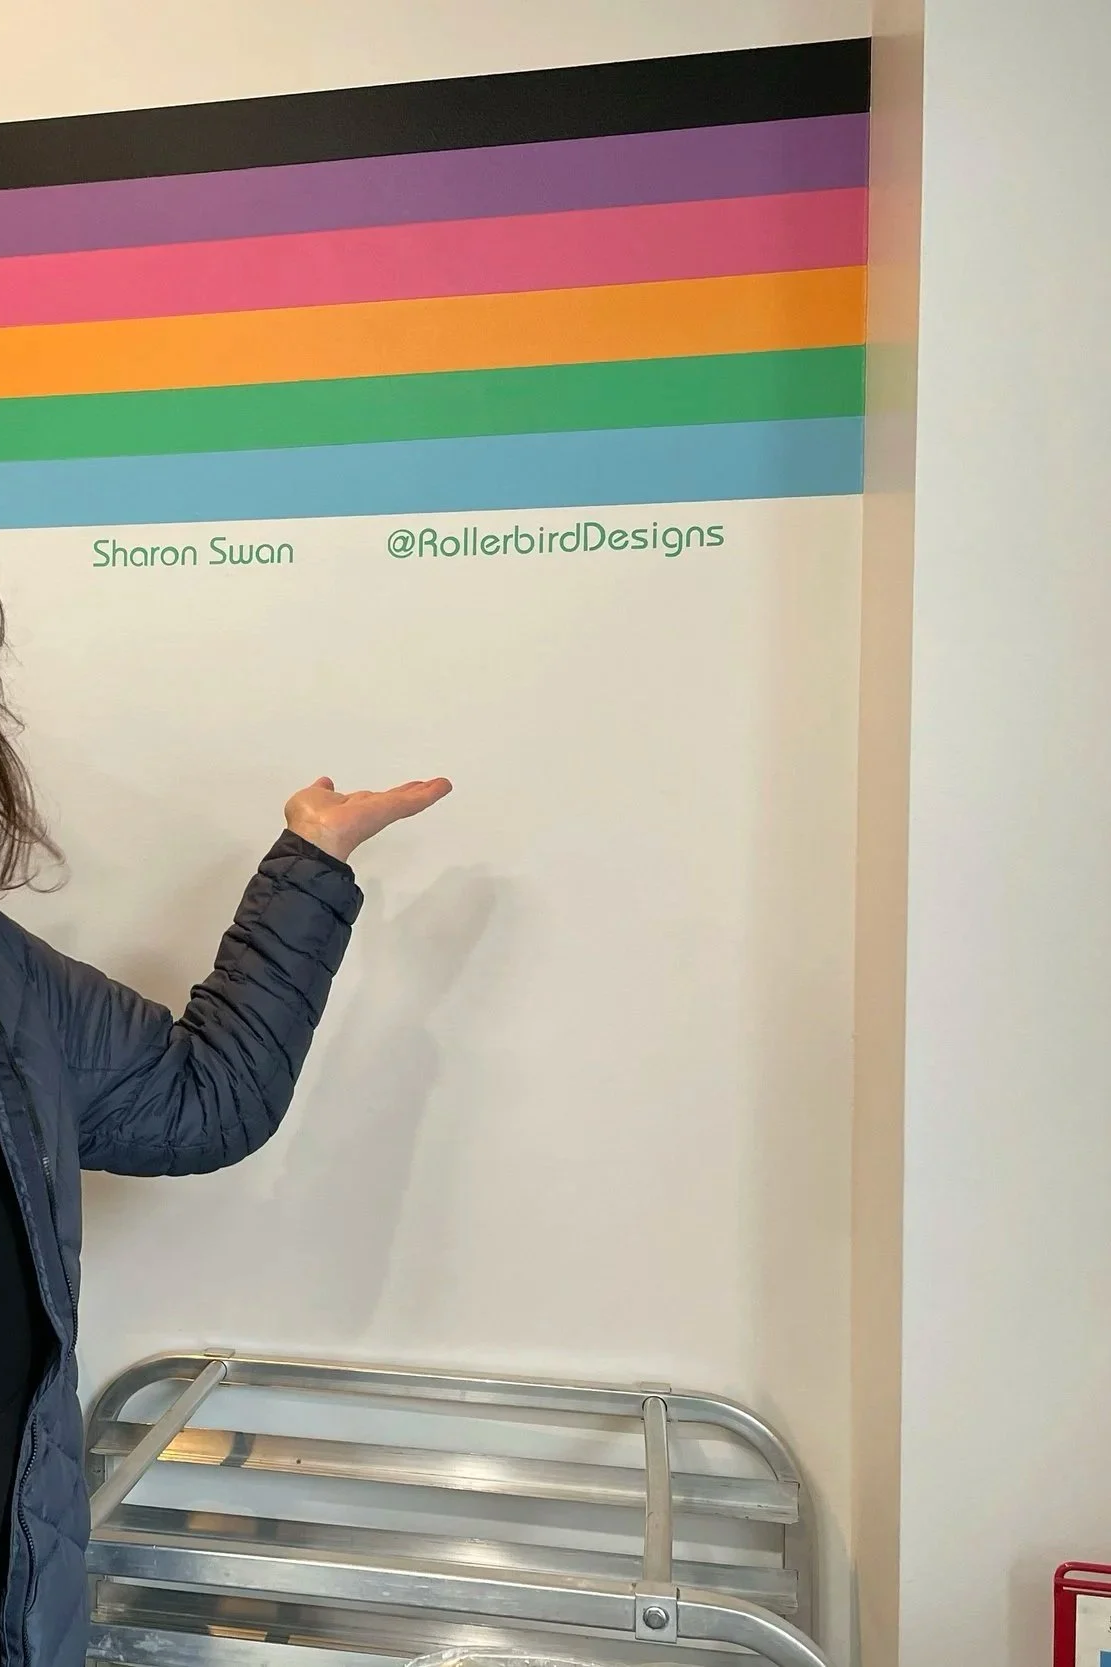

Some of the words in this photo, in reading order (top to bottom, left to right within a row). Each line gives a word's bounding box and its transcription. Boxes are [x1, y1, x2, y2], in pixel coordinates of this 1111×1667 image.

[92, 538, 198, 567] Sharon
[208, 536, 295, 565] Swan
[386, 521, 726, 558] @RollerbirdDesigns
